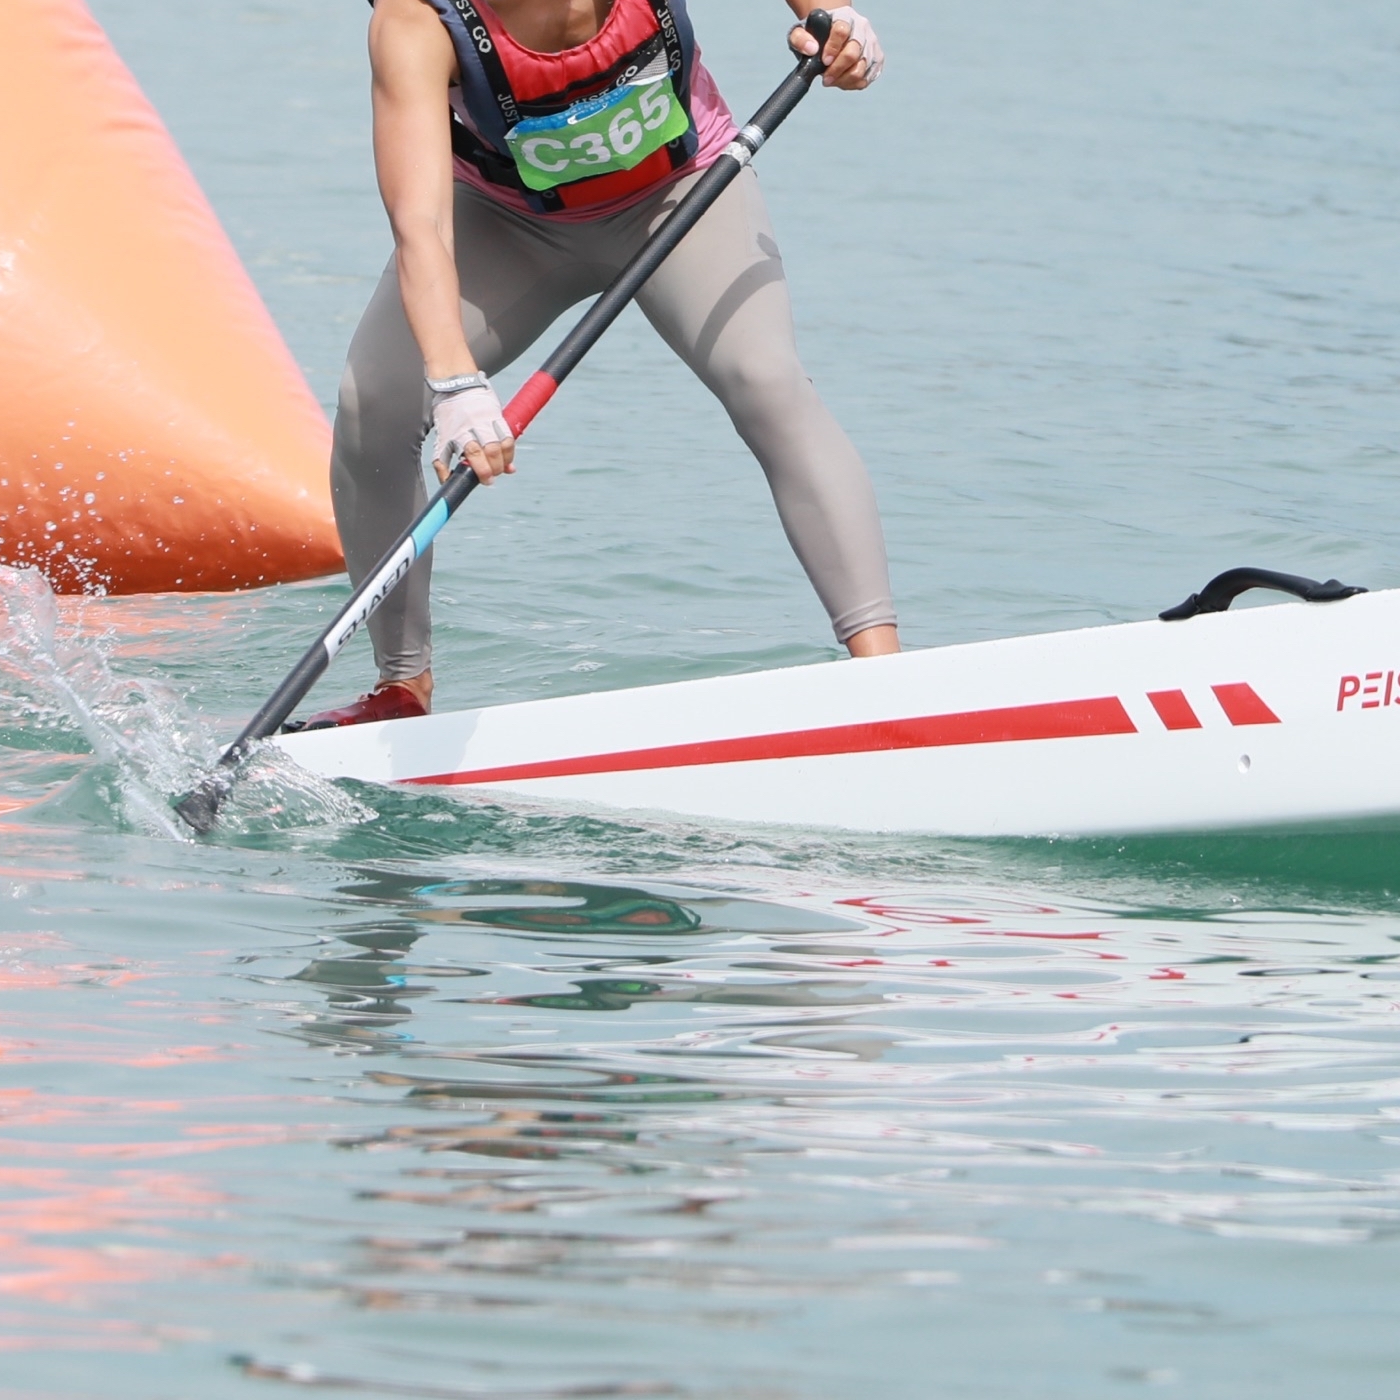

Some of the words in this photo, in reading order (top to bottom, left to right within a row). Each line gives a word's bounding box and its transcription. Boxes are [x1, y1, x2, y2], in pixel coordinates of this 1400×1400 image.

[472, 25, 492, 53] GO
[657, 8, 678, 47] JUST
[616, 65, 638, 87] GO
[520, 81, 671, 173] C365
